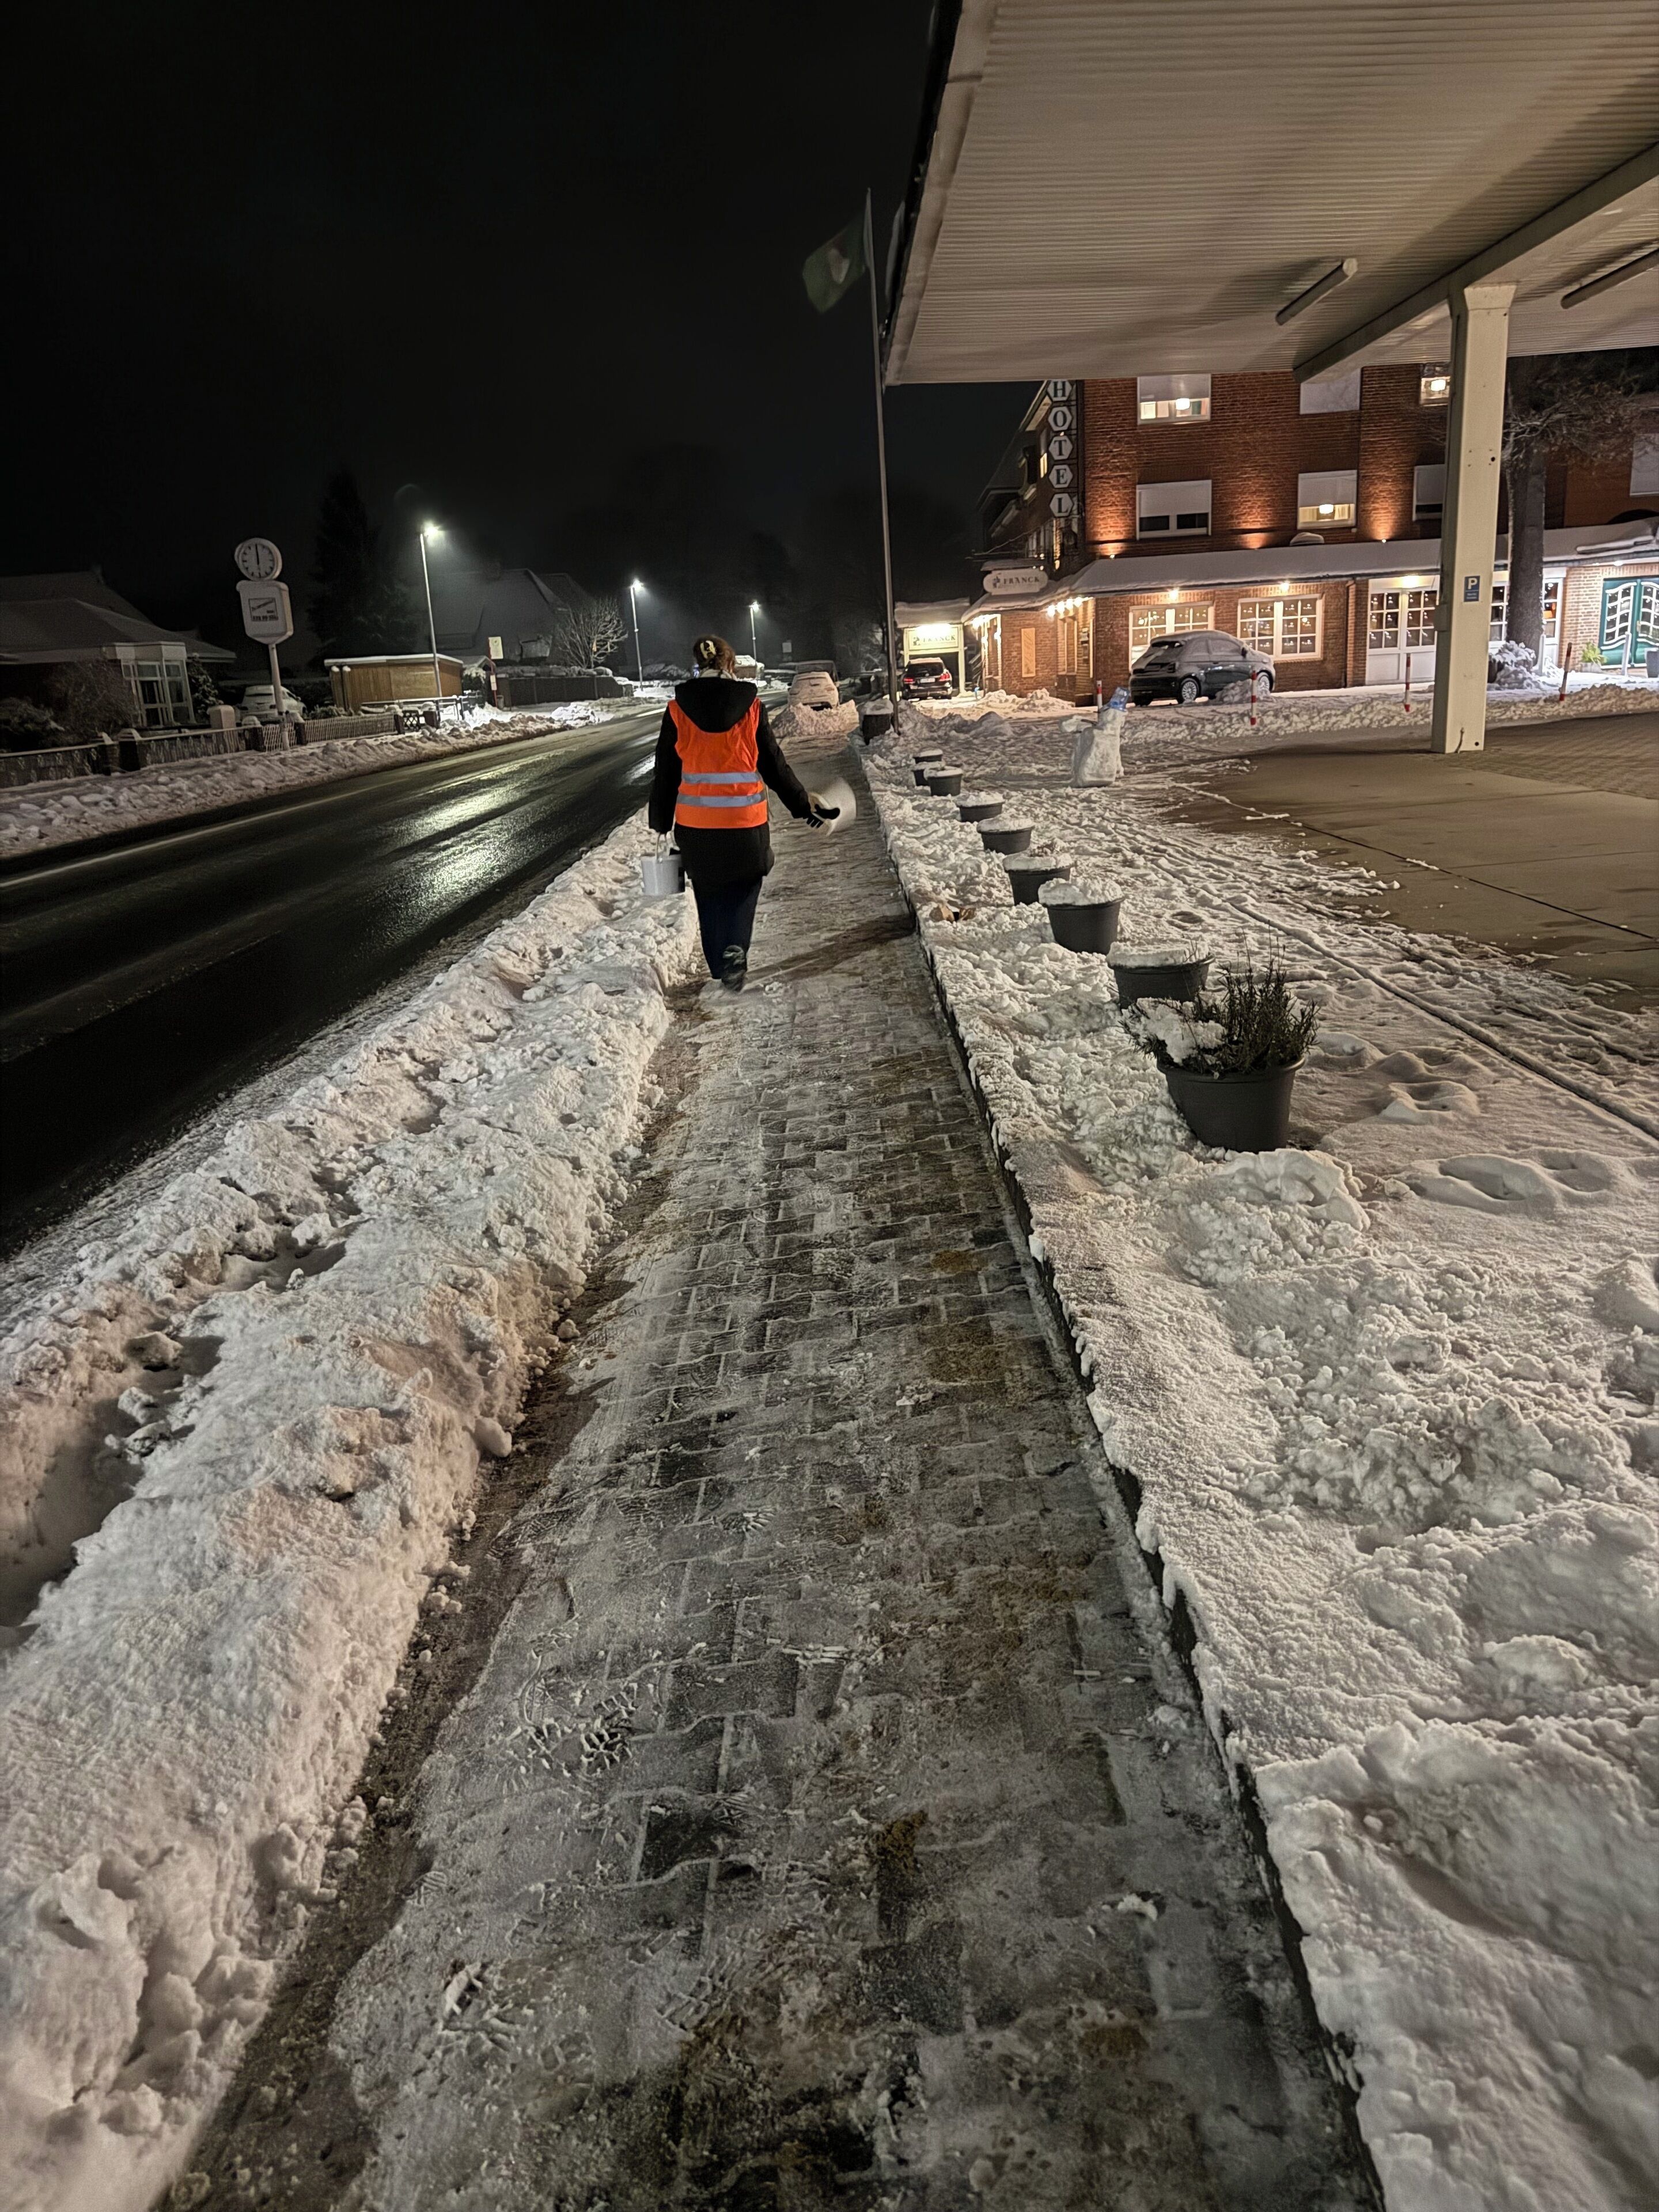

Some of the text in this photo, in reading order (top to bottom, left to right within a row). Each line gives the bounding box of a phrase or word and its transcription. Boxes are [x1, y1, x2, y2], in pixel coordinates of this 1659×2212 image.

[1053, 381, 1067, 513] HOTEL
[1003, 576, 1040, 585] FRANCK
[1468, 577, 1478, 590] P
